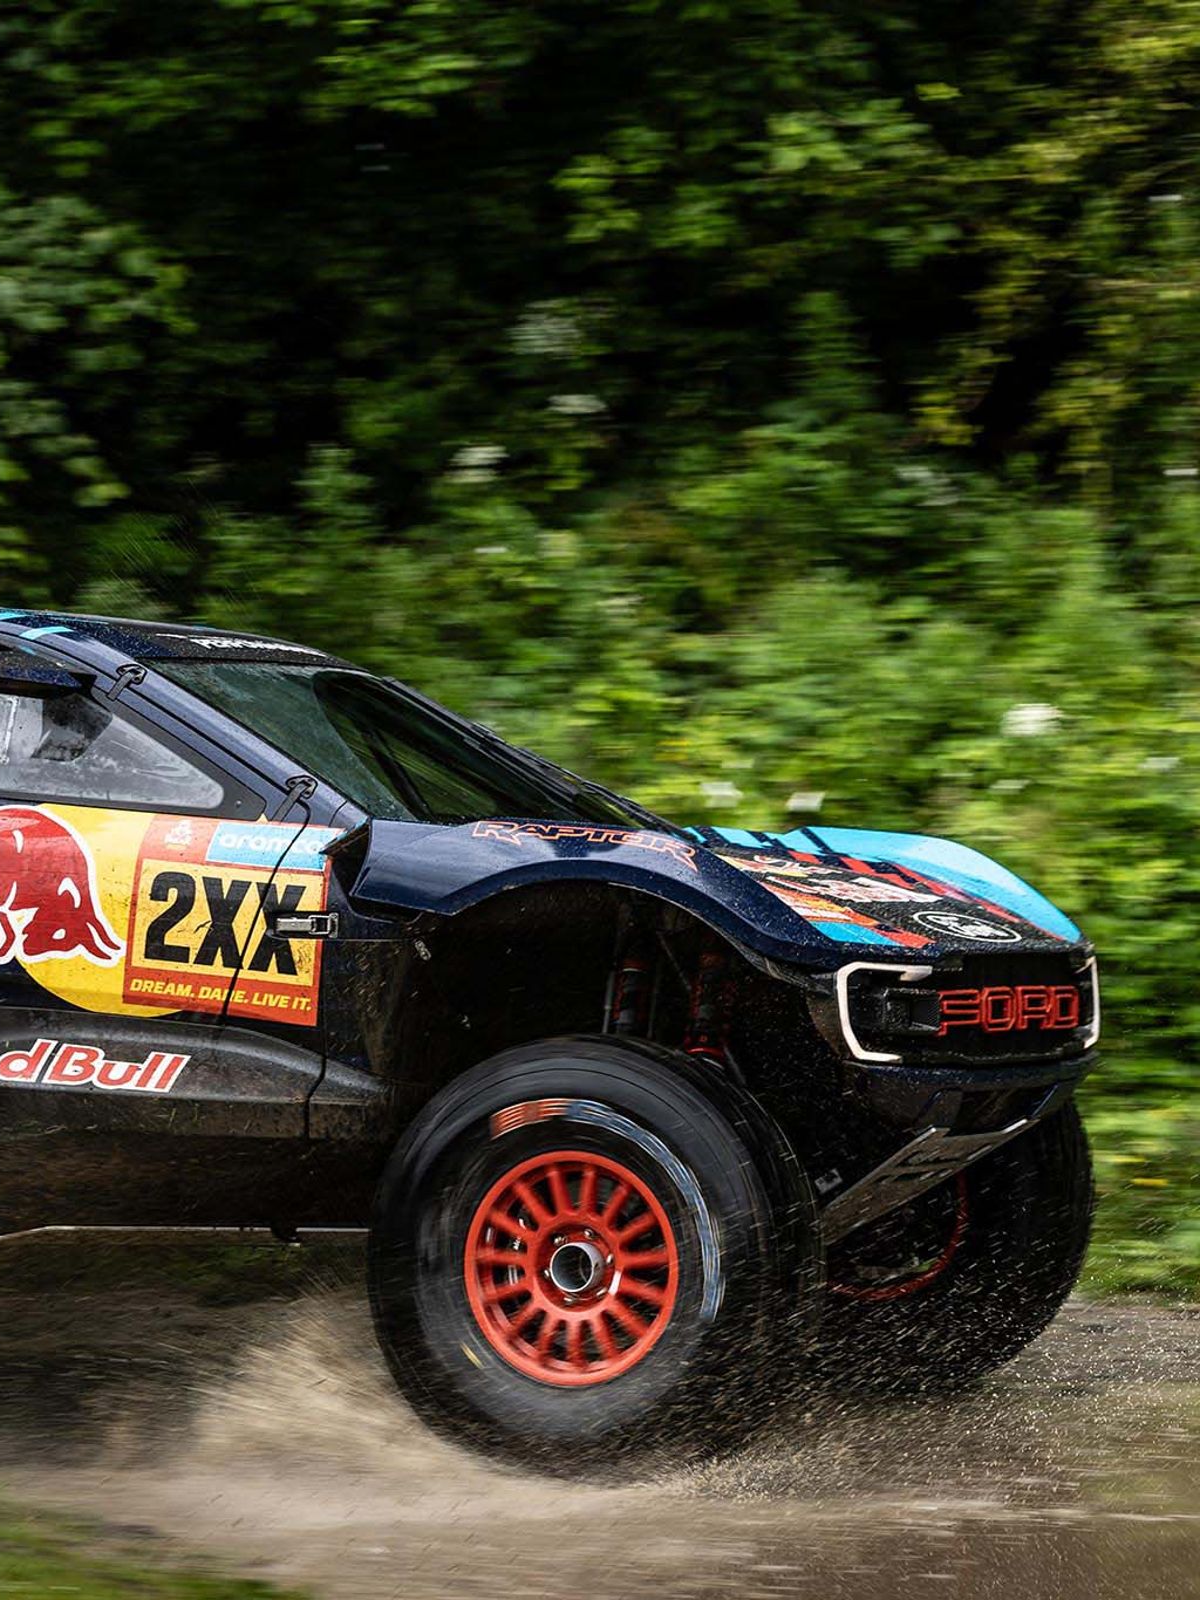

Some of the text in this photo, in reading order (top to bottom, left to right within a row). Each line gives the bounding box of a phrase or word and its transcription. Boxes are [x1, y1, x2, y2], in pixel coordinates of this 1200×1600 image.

[219, 832, 323, 854] aramco
[472, 821, 698, 872] RAPTOR
[144, 871, 306, 975] 2XX
[130, 979, 195, 998] DREAM.
[251, 992, 291, 1008] LIVE
[292, 998, 312, 1011] IT.
[936, 985, 1079, 1036] FORD
[44, 1044, 189, 1092] Bull
